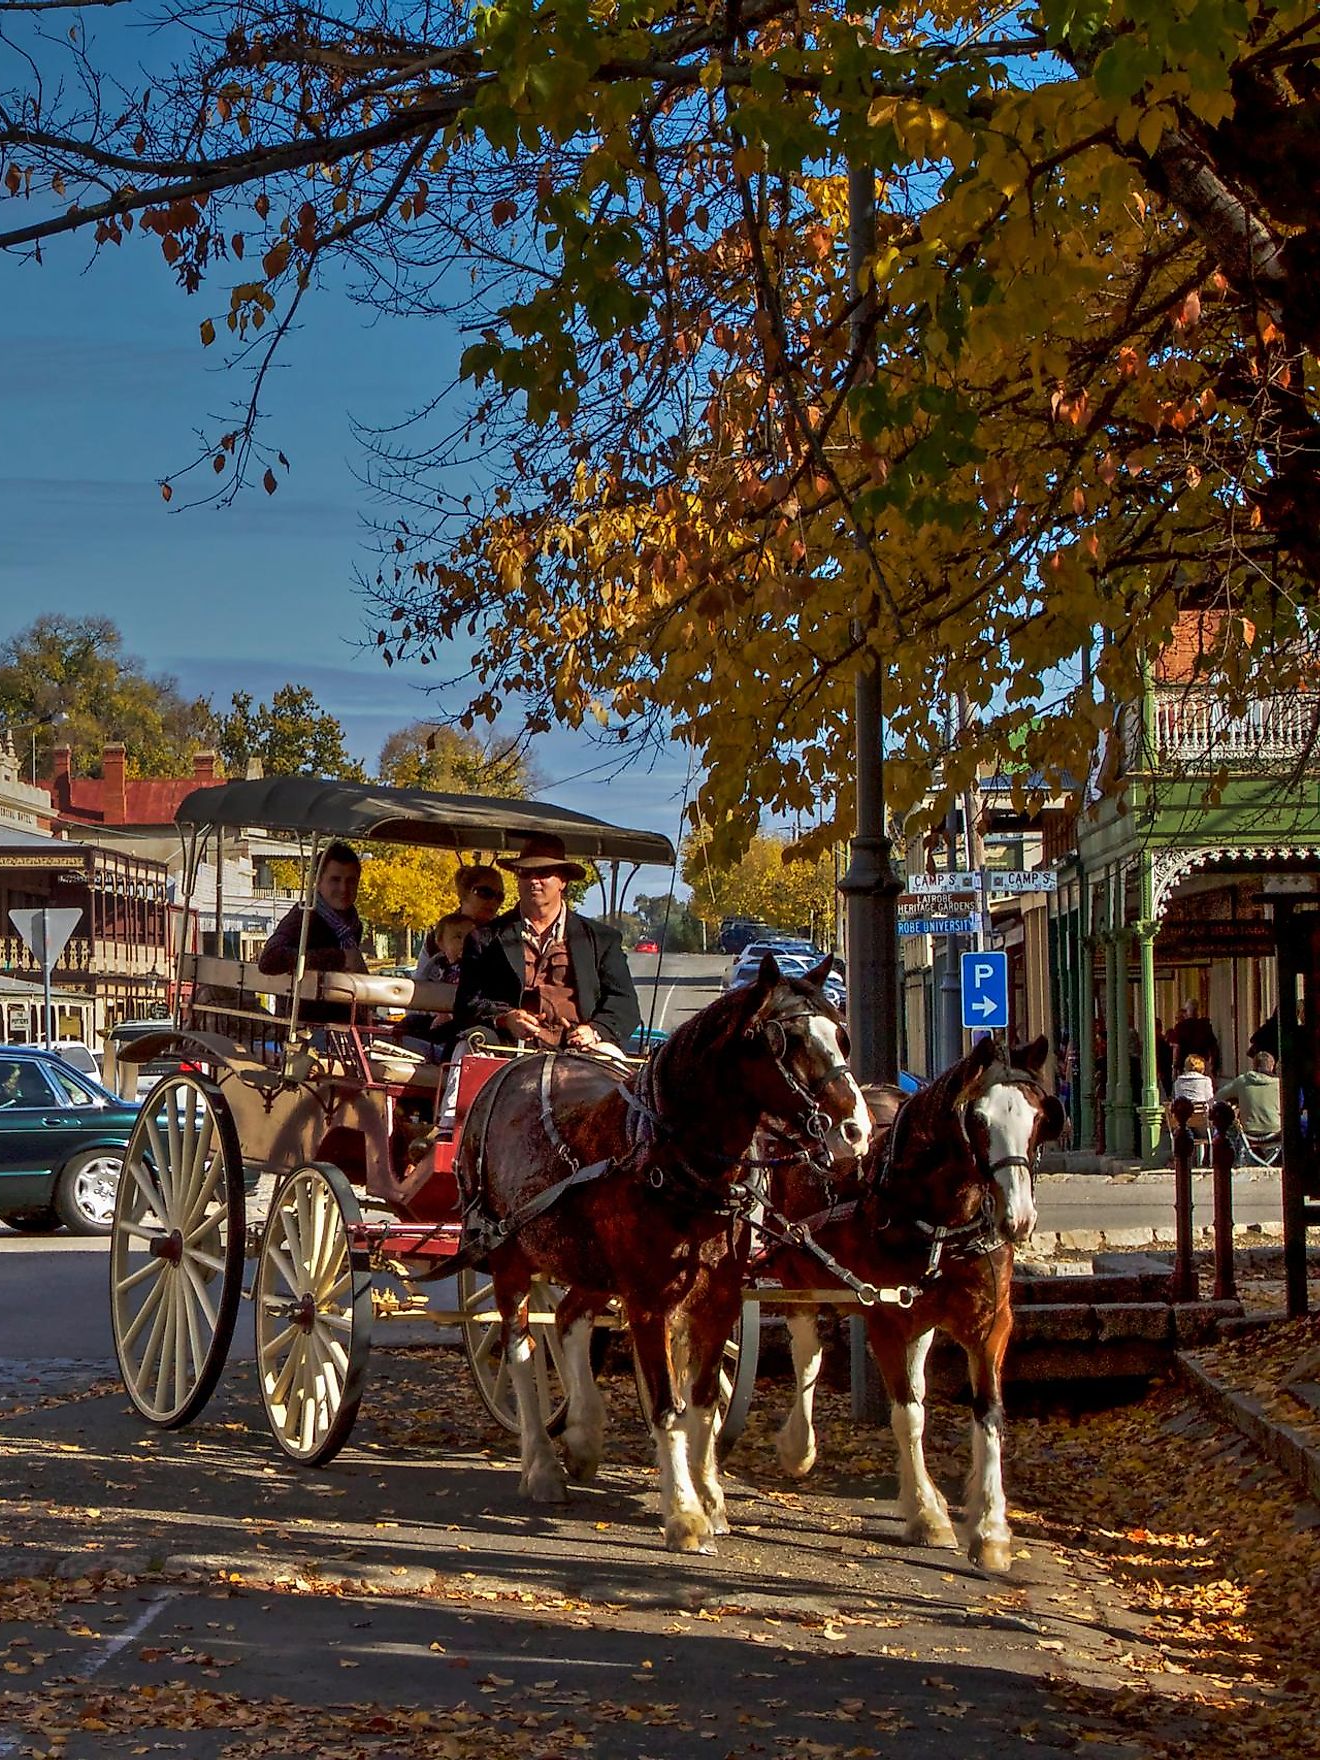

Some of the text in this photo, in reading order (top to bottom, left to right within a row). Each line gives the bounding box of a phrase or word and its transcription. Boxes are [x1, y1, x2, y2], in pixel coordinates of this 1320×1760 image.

[914, 874, 944, 887] CAMP
[1008, 872, 1039, 885] CAMP
[916, 894, 953, 904] LATROBE
[897, 901, 975, 914] HERITAGE GARDENS
[897, 918, 974, 934] ROBE UNIVERSITY
[974, 964, 994, 988] P
